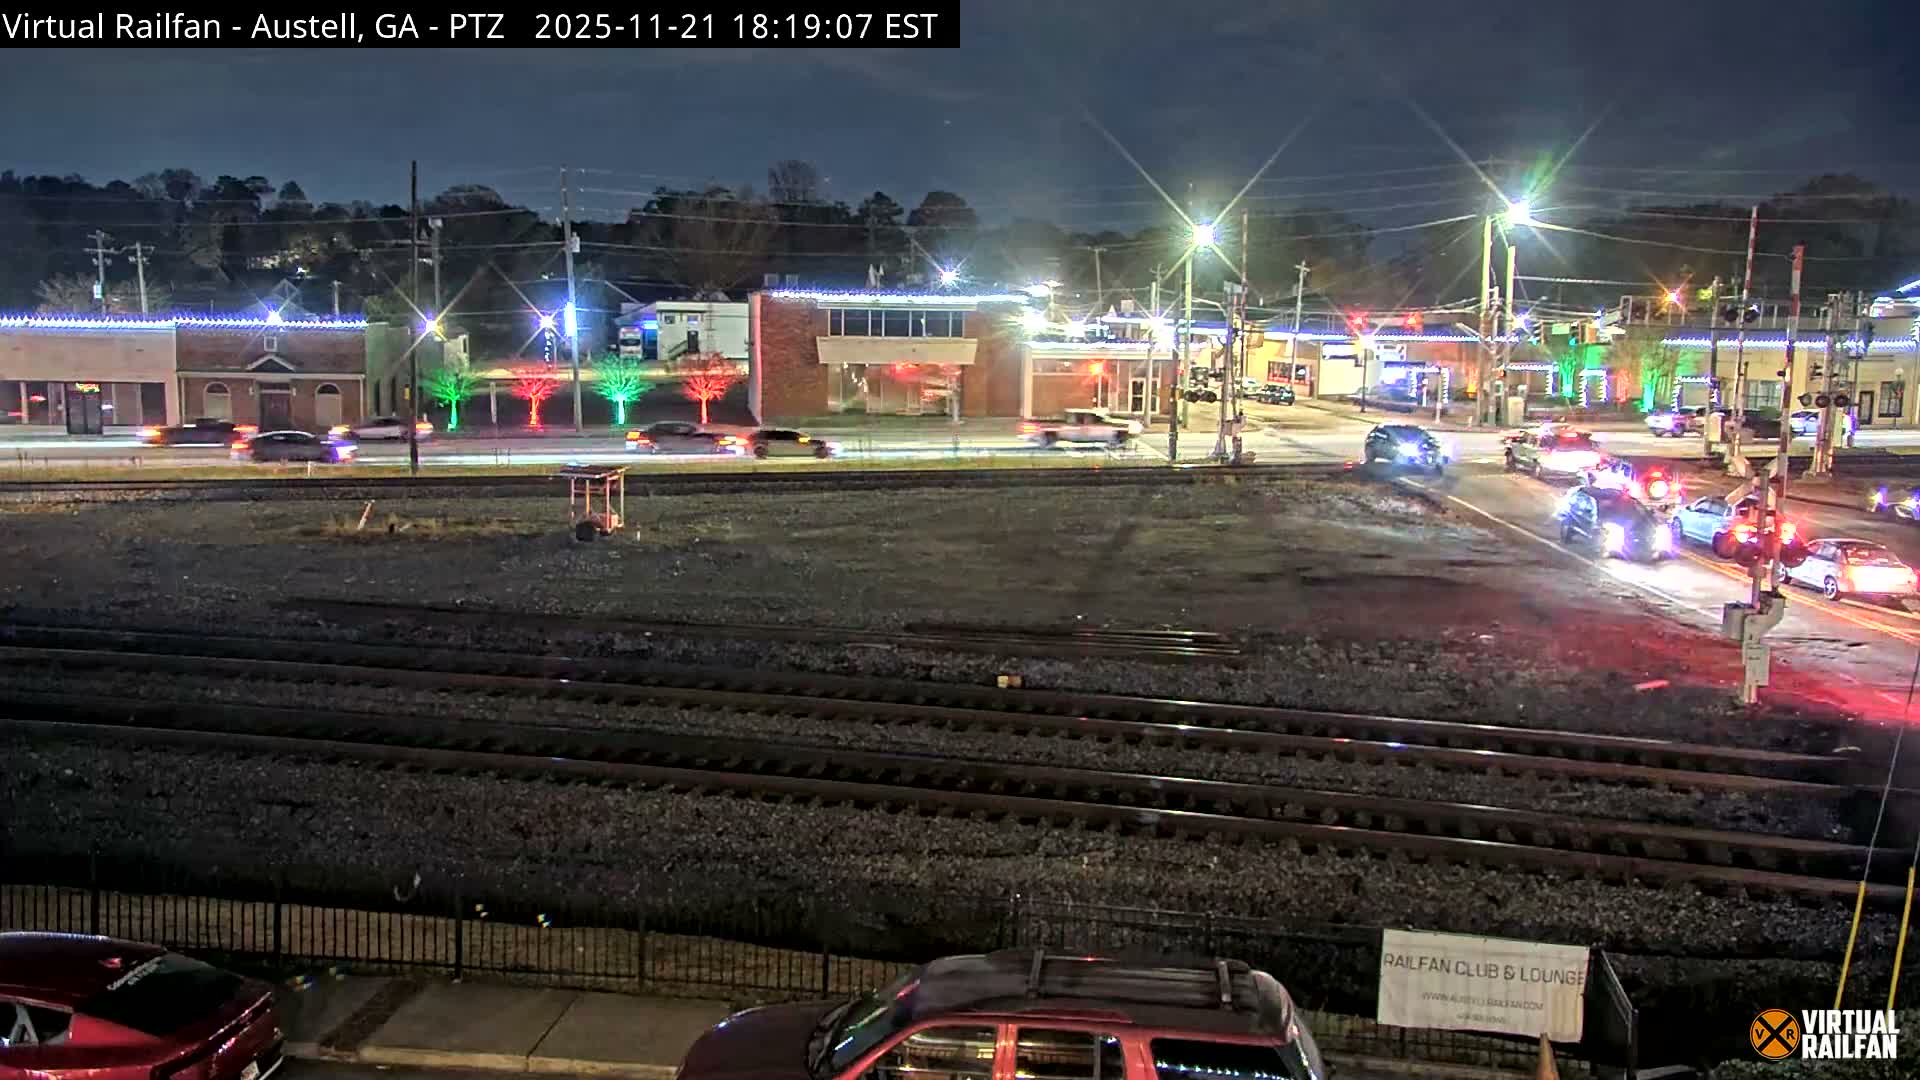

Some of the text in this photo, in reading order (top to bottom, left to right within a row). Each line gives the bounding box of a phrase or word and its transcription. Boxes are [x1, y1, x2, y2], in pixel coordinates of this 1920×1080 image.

[1383, 953, 1586, 985] RAILFAN CLUB & LOUNGE
